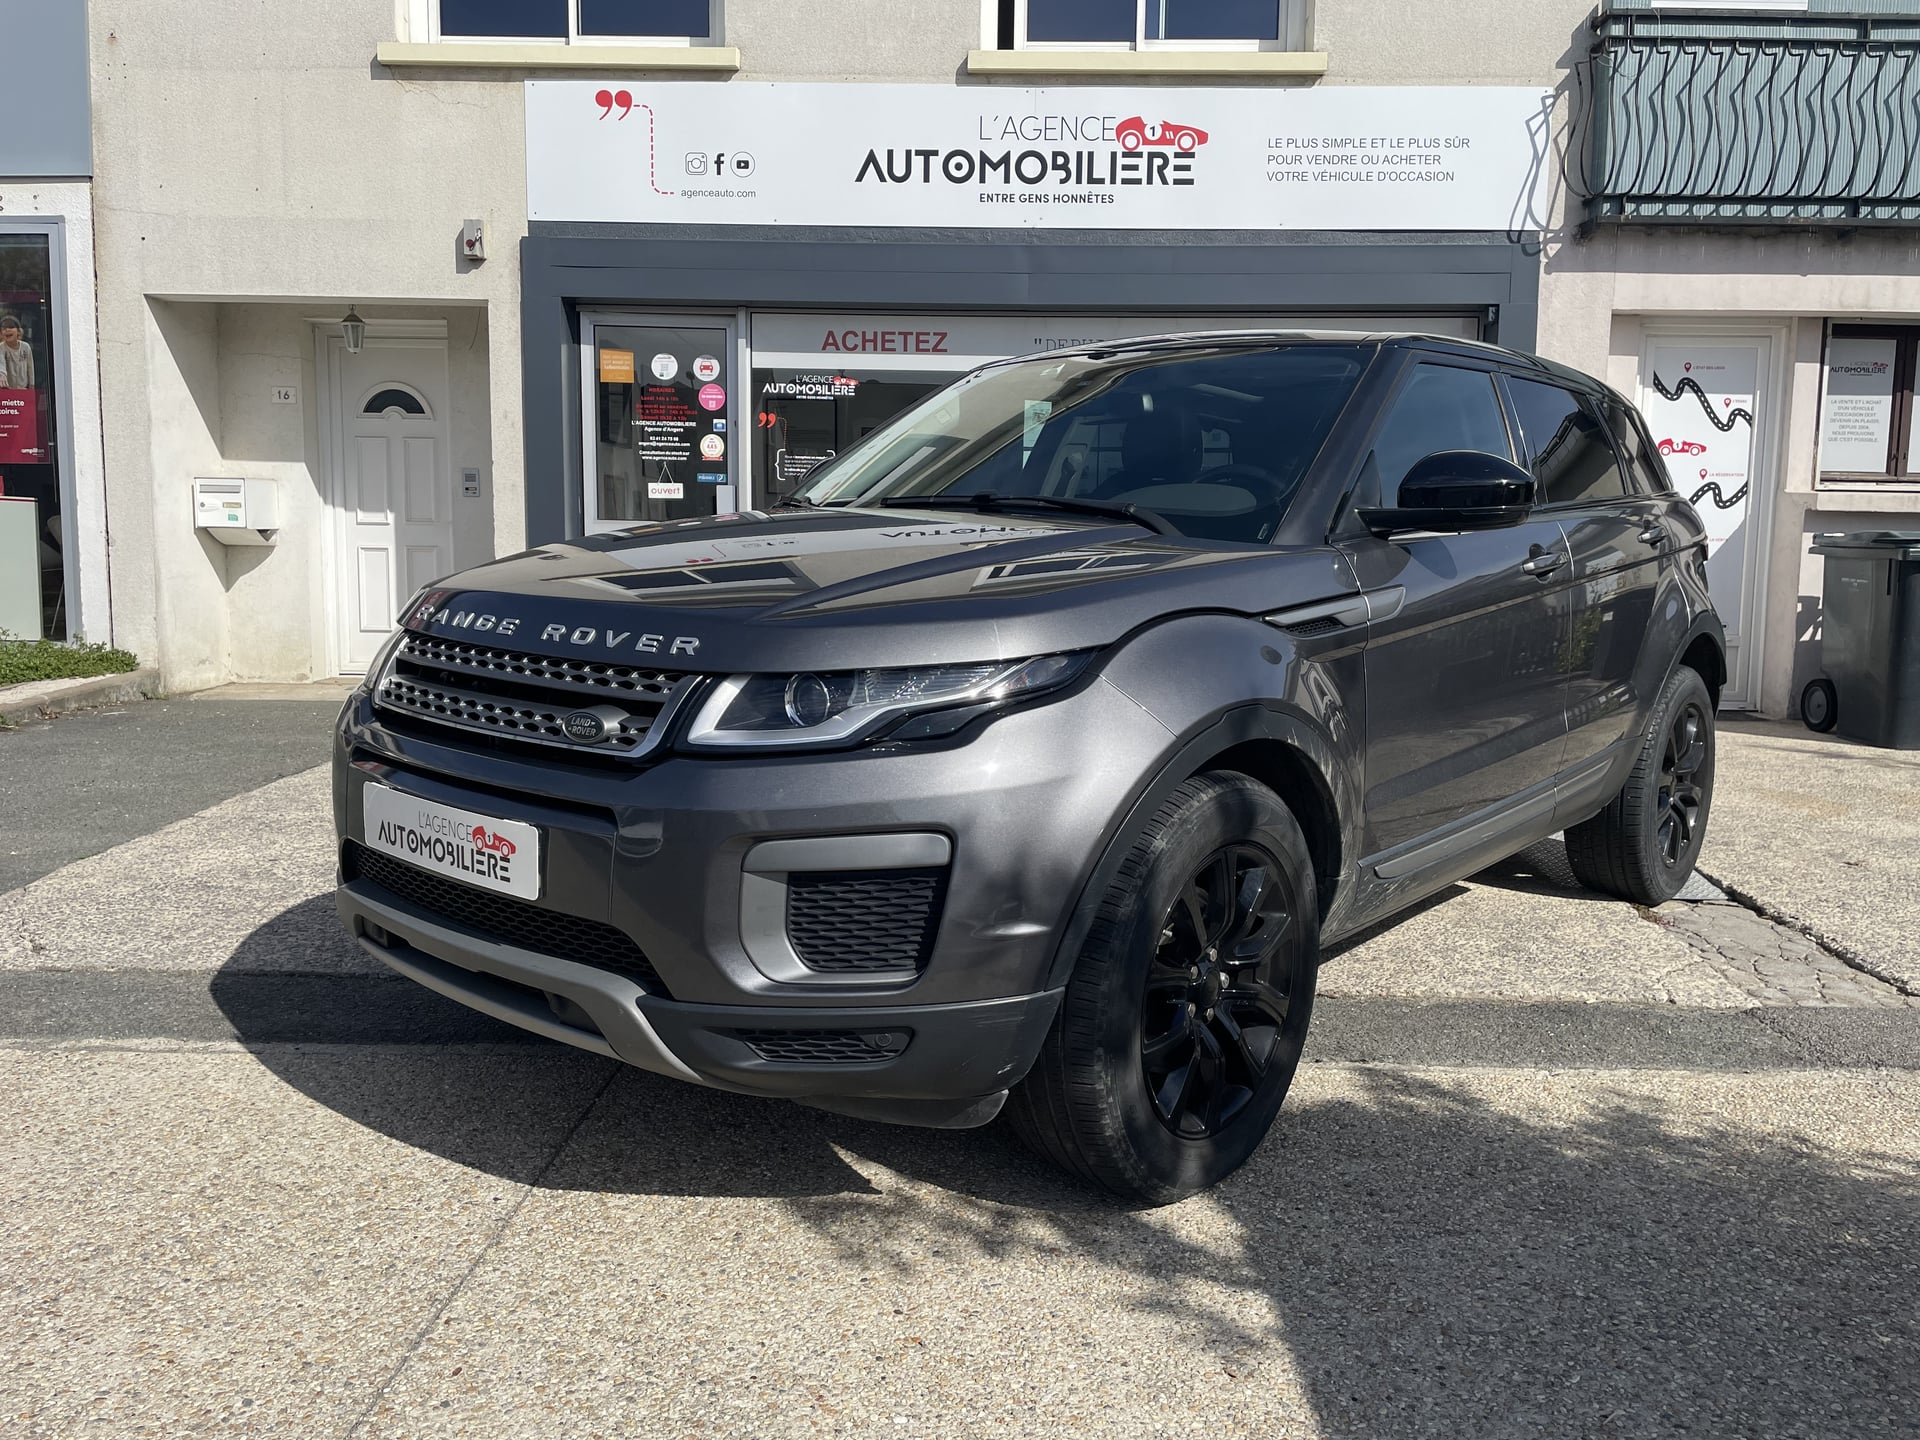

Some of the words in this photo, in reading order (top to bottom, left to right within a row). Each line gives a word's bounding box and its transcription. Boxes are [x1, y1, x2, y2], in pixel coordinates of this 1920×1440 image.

[979, 115, 1116, 142] L'AGENCE
[1268, 138, 1283, 148] LE
[1286, 138, 1318, 148] PLUS
[1322, 138, 1367, 148] SIMPLE
[1370, 138, 1386, 148] ET
[1390, 138, 1405, 148] LE
[1408, 138, 1440, 149] PLUS
[1444, 136, 1470, 149] SÛR
[1267, 154, 1302, 165] POUR
[1306, 154, 1357, 165] VENDRE
[1361, 154, 1379, 165] OU
[1382, 154, 1441, 165] ACHETER
[1267, 171, 1309, 182] VOTRE
[1312, 169, 1373, 182] VÉHICULE
[1378, 171, 1454, 182] D'OCCASION
[681, 187, 756, 199] agenceauto.com
[979, 193, 1017, 203] ENTRE
[1019, 193, 1050, 204] GENS
[1053, 191, 1115, 204] HONNÊTES
[821, 330, 948, 353] ACHETEZ
[277, 389, 290, 400] 16
[1, 399, 25, 407] miette
[650, 486, 681, 495] ouvert
[416, 604, 521, 636] RANGE
[540, 623, 701, 656] ROVER
[418, 810, 473, 843] L'AGENCE
